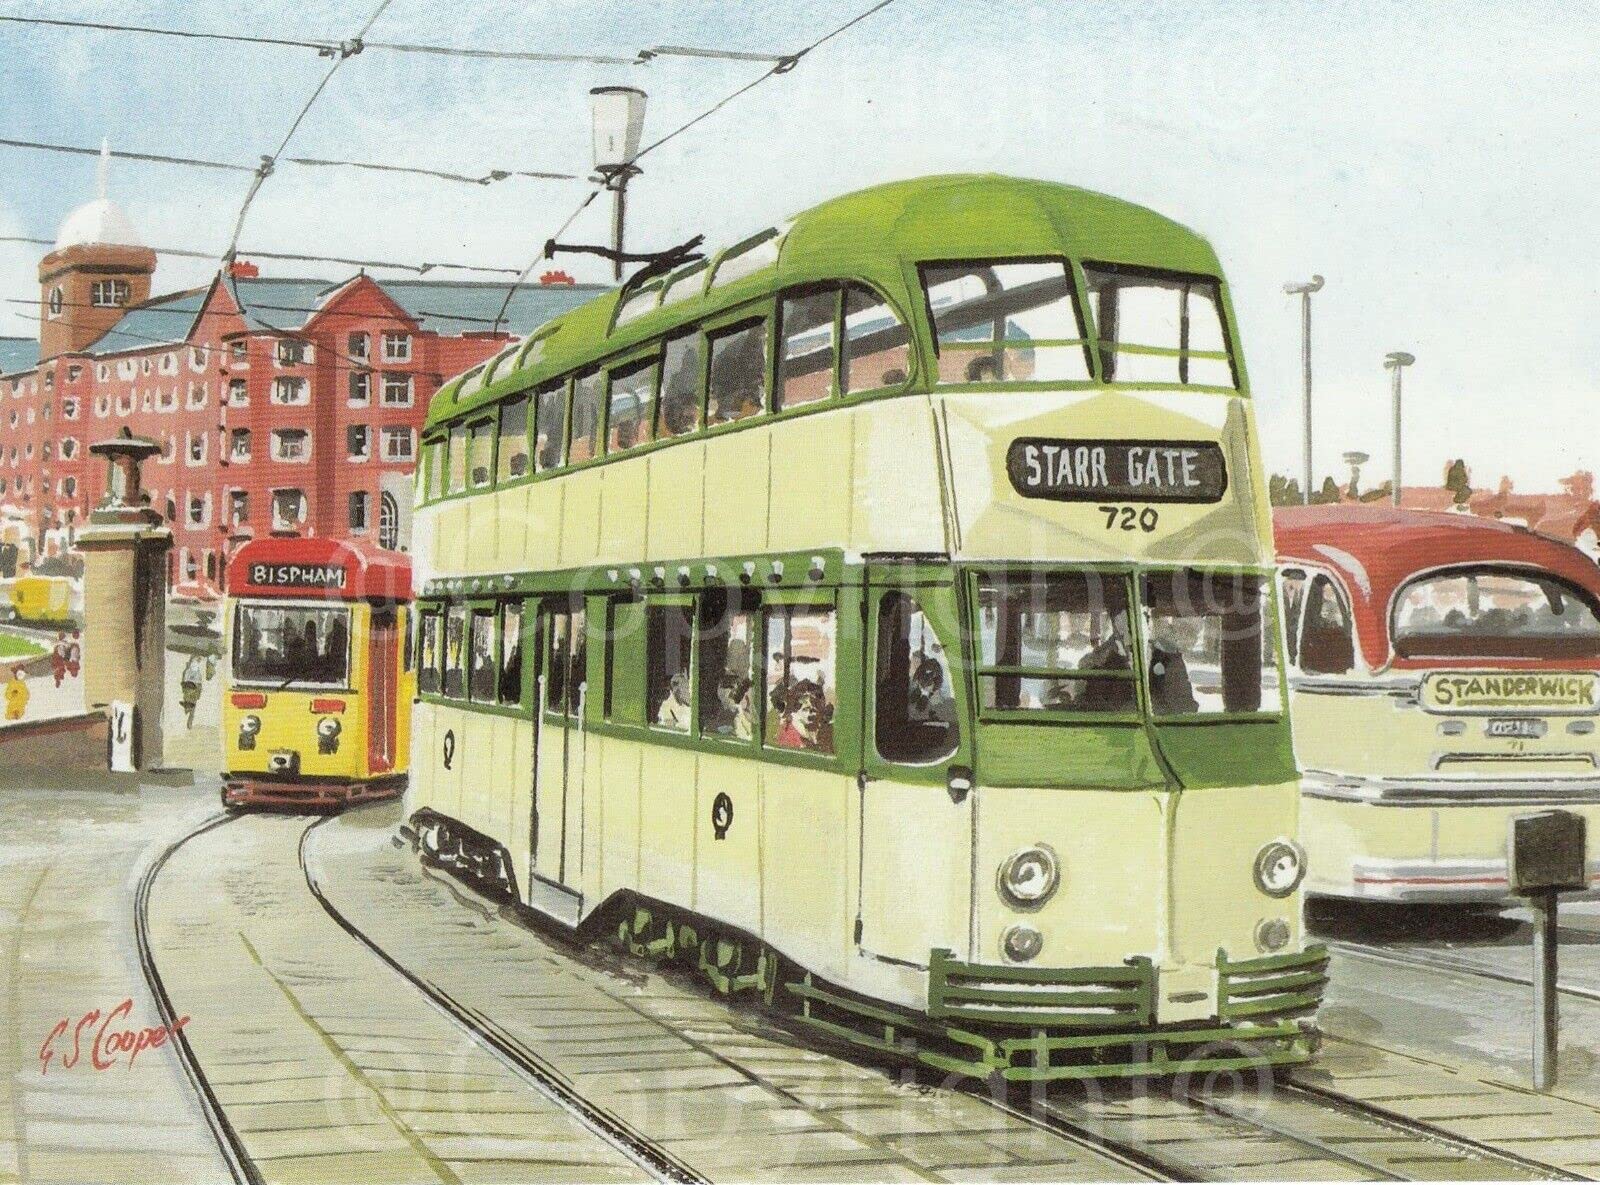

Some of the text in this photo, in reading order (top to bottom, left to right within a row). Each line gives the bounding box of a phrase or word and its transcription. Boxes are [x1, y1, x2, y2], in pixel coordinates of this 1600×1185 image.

[1025, 445, 1200, 487] STARR GATE
[1099, 506, 1158, 532] 720
[253, 565, 342, 589] BISPHAM
[1435, 677, 1595, 705] STANDERWICK
